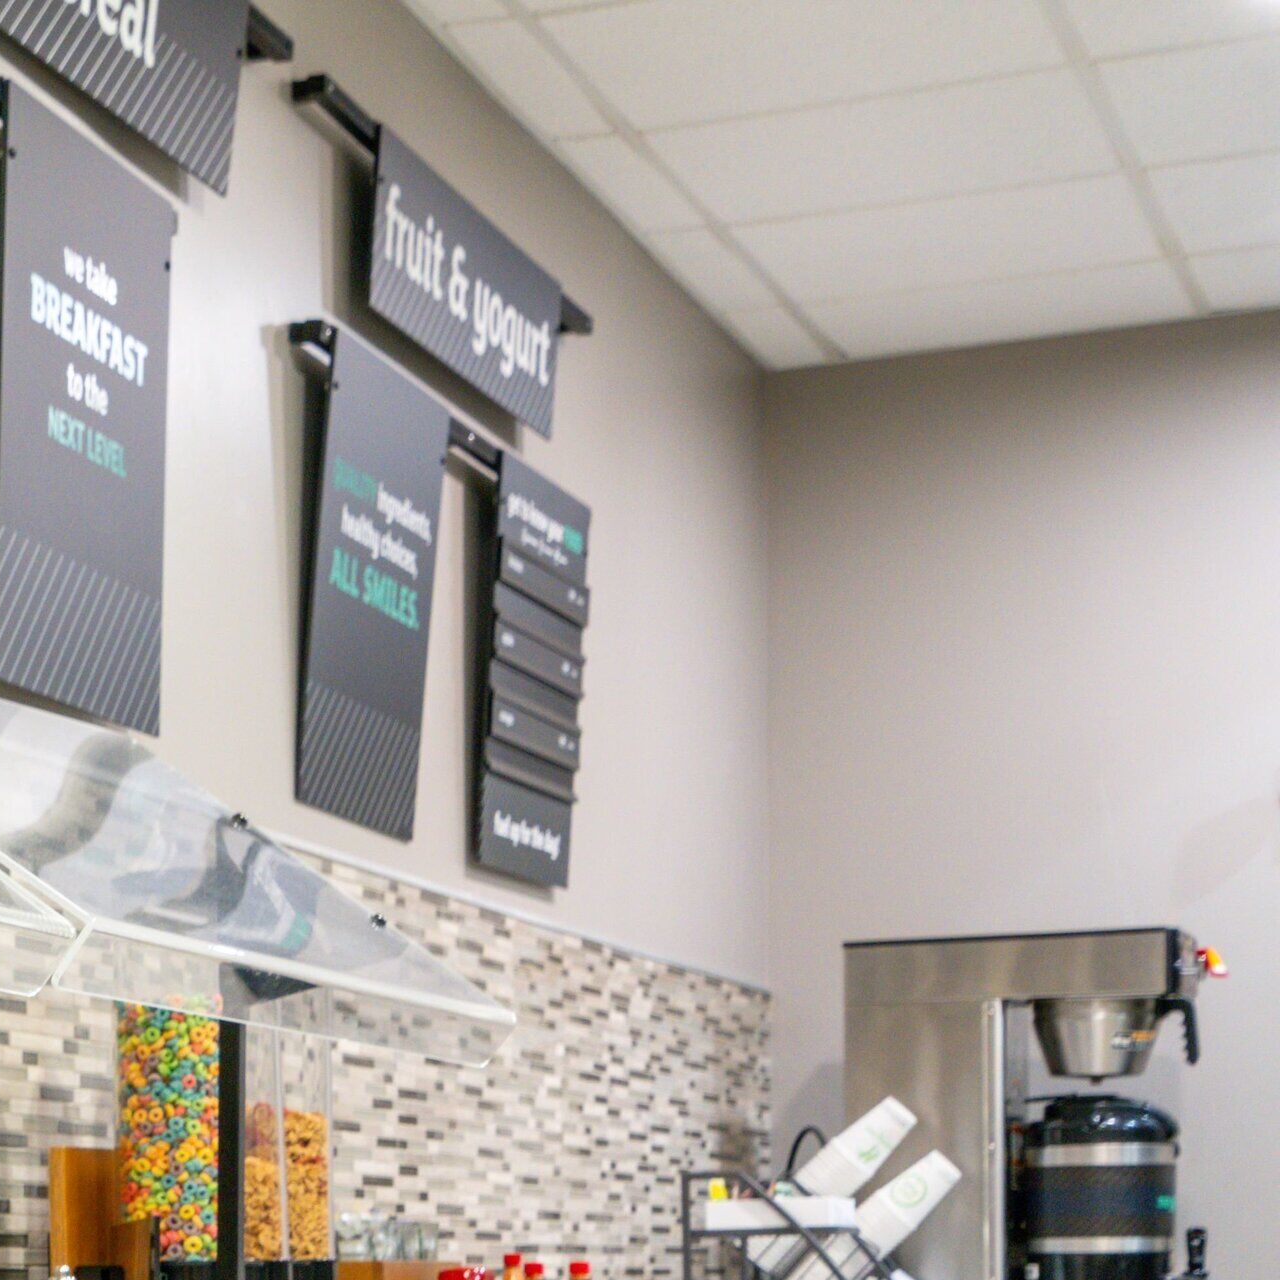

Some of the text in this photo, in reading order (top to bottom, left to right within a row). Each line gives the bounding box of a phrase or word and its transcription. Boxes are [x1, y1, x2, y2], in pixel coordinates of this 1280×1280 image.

[64, 246, 117, 306] we take
[385, 183, 551, 387] fruit & yogurt
[30, 272, 148, 387] BREAKFAST
[67, 362, 109, 416] to the
[48, 404, 85, 453] NEXT
[330, 546, 360, 598] ALL
